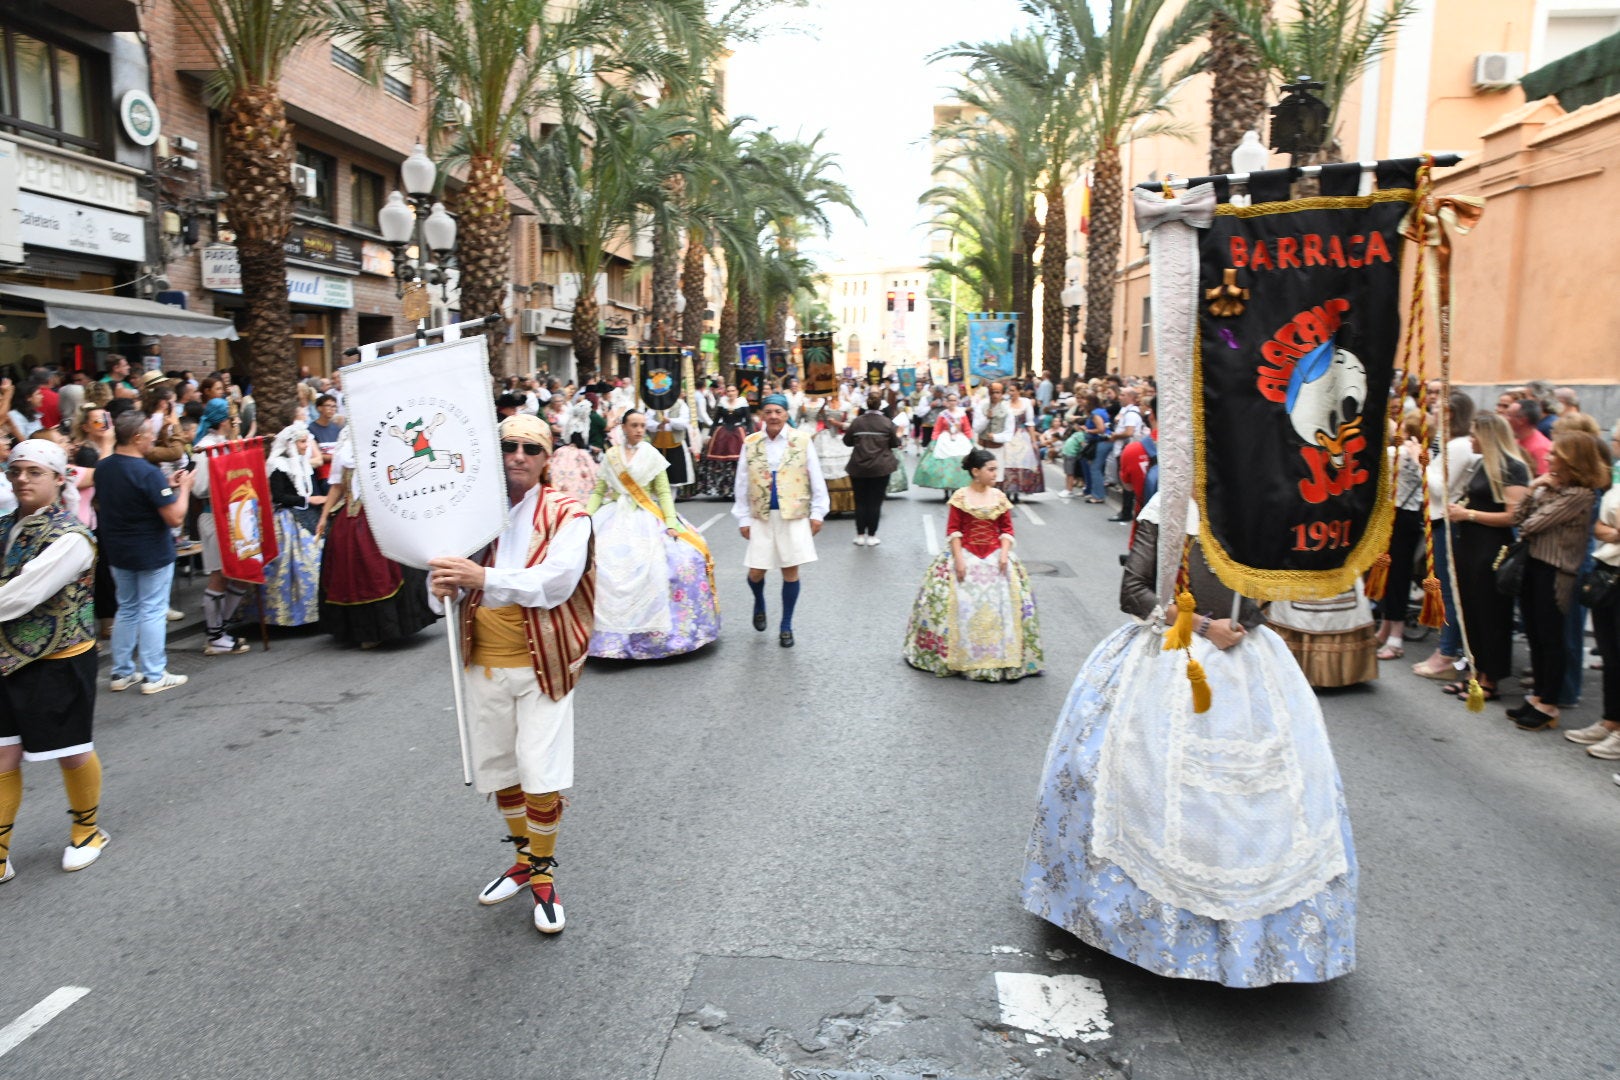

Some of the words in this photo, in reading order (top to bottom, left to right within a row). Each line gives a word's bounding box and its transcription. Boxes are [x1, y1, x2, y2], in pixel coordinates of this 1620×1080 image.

[1229, 231, 1393, 271] BARRACA
[1256, 298, 1351, 404] ALACANT
[369, 405, 403, 469] BARRACA
[397, 481, 456, 501] ALACANT
[1297, 435, 1370, 504] JOE
[1291, 519, 1352, 553] 1991
